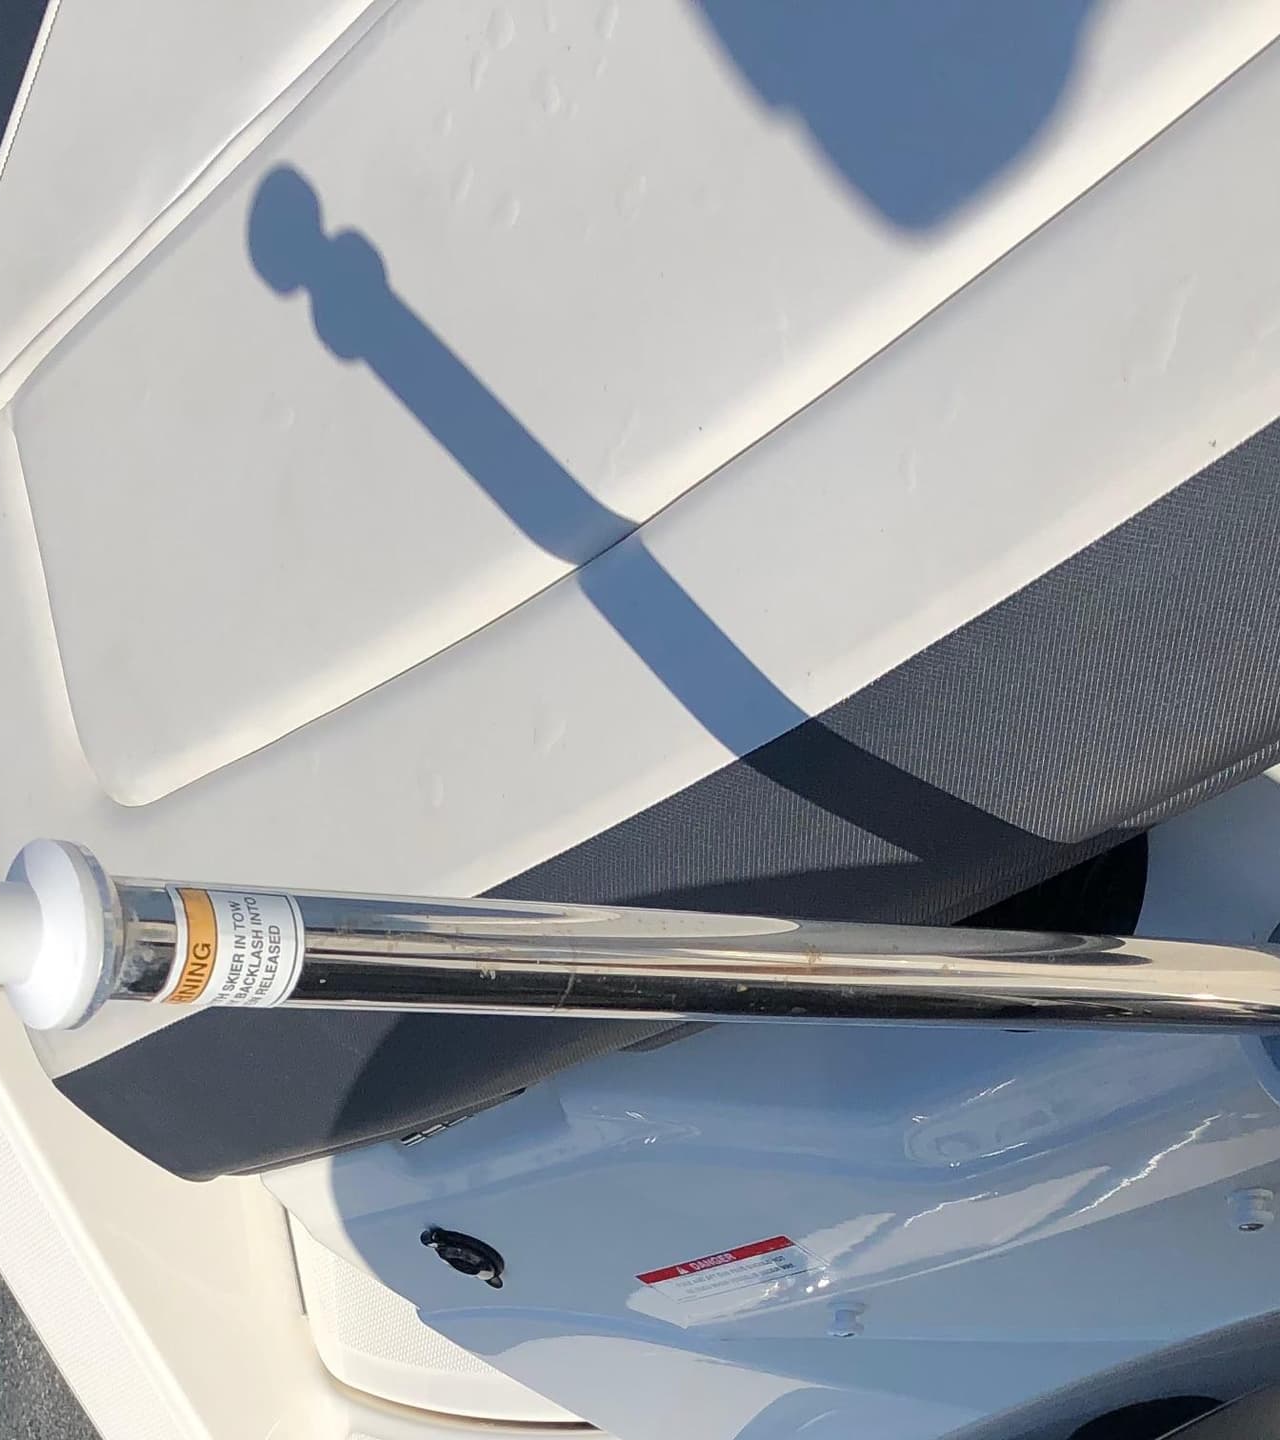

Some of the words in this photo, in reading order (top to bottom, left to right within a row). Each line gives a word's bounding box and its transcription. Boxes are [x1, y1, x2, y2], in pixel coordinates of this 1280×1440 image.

[228, 900, 246, 931] TOW
[244, 896, 262, 926] INTO
[234, 935, 246, 949] IN
[222, 953, 245, 992] SKIER
[234, 929, 264, 999] BACKLASH
[255, 925, 281, 995] RELEASED
[688, 1253, 737, 1271] DANGER
